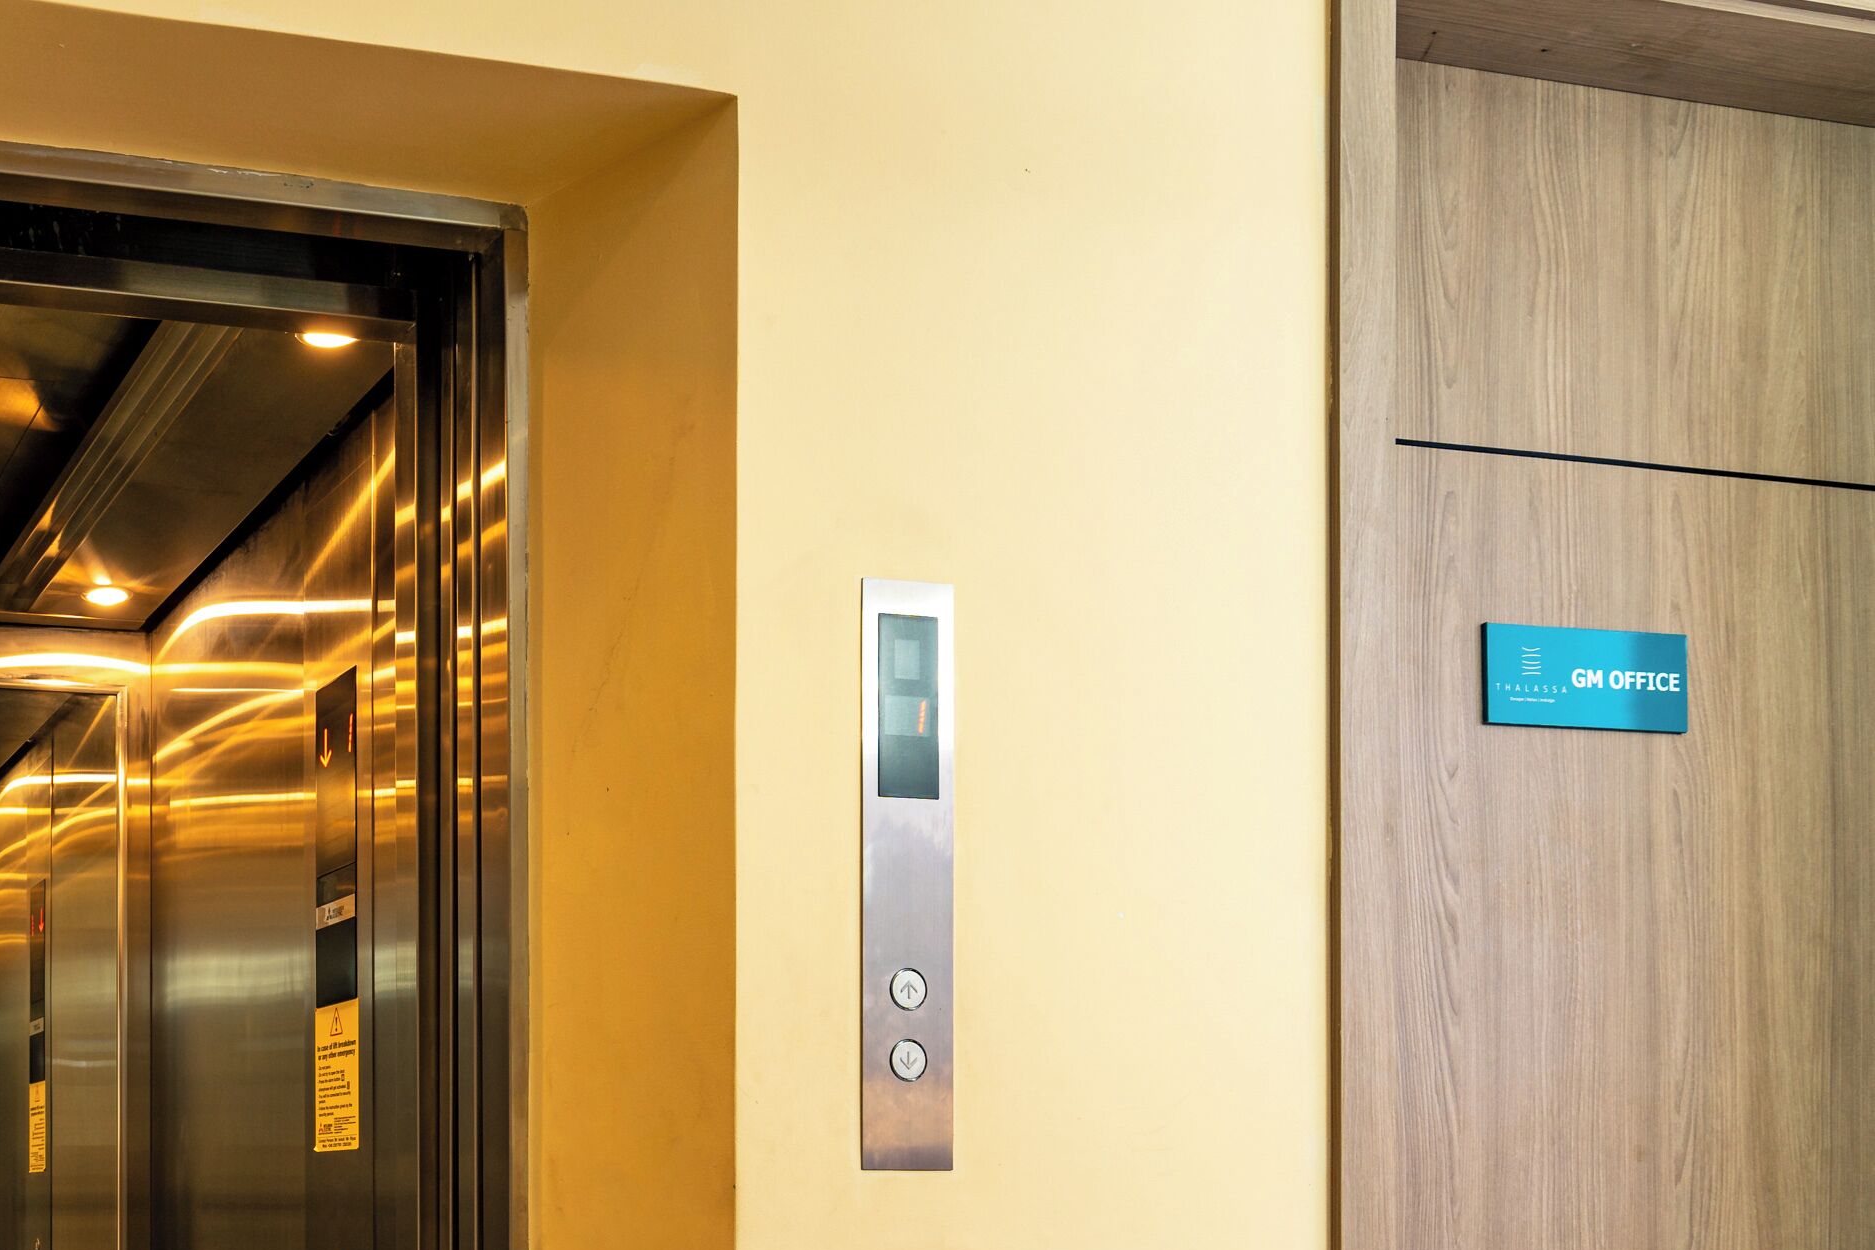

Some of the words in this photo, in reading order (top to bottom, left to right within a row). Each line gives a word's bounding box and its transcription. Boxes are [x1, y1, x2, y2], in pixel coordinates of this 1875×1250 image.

[1495, 682, 1567, 694] THALASSA
[1571, 668, 1603, 688] GM
[1609, 670, 1680, 692] OFFICE
